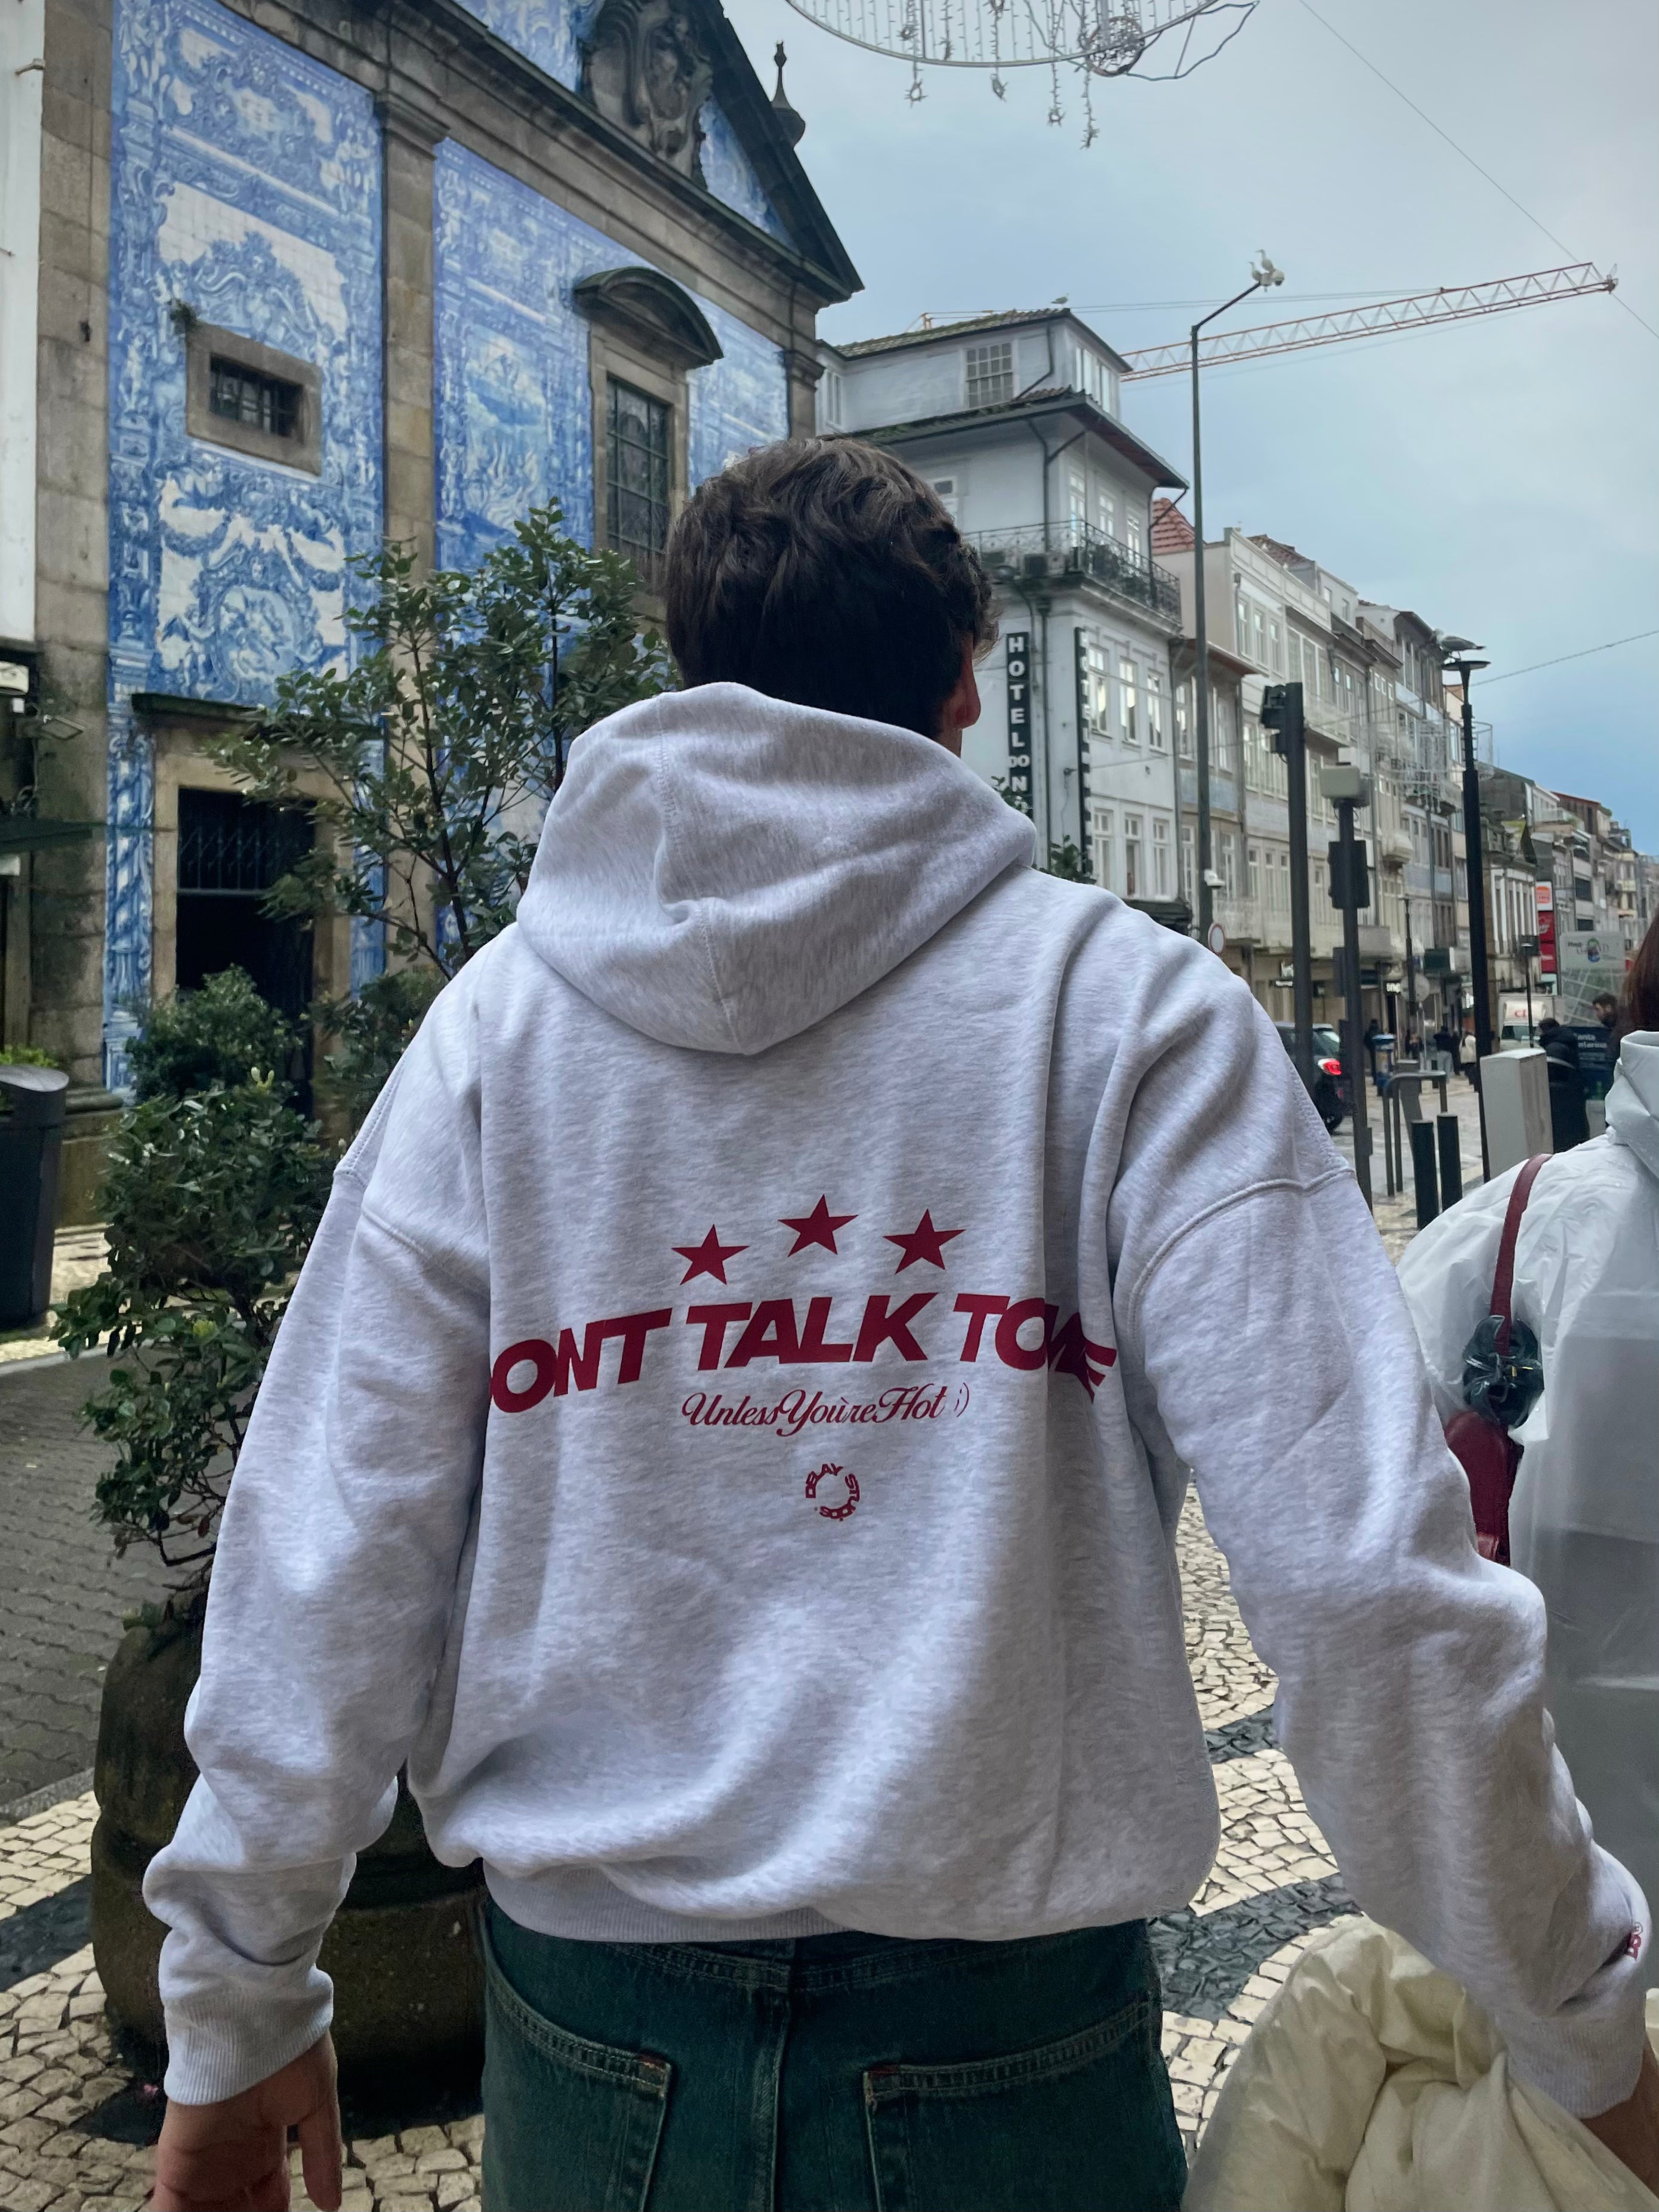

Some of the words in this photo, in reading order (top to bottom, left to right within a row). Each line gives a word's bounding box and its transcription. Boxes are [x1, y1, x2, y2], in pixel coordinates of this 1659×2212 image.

[1009, 636, 1025, 748] HOTEL
[489, 1307, 673, 1414] ONT
[686, 1292, 938, 1371] TALK
[953, 1293, 1046, 1371] TO
[682, 1392, 779, 1426] Unless
[872, 1383, 948, 1423] Hot
